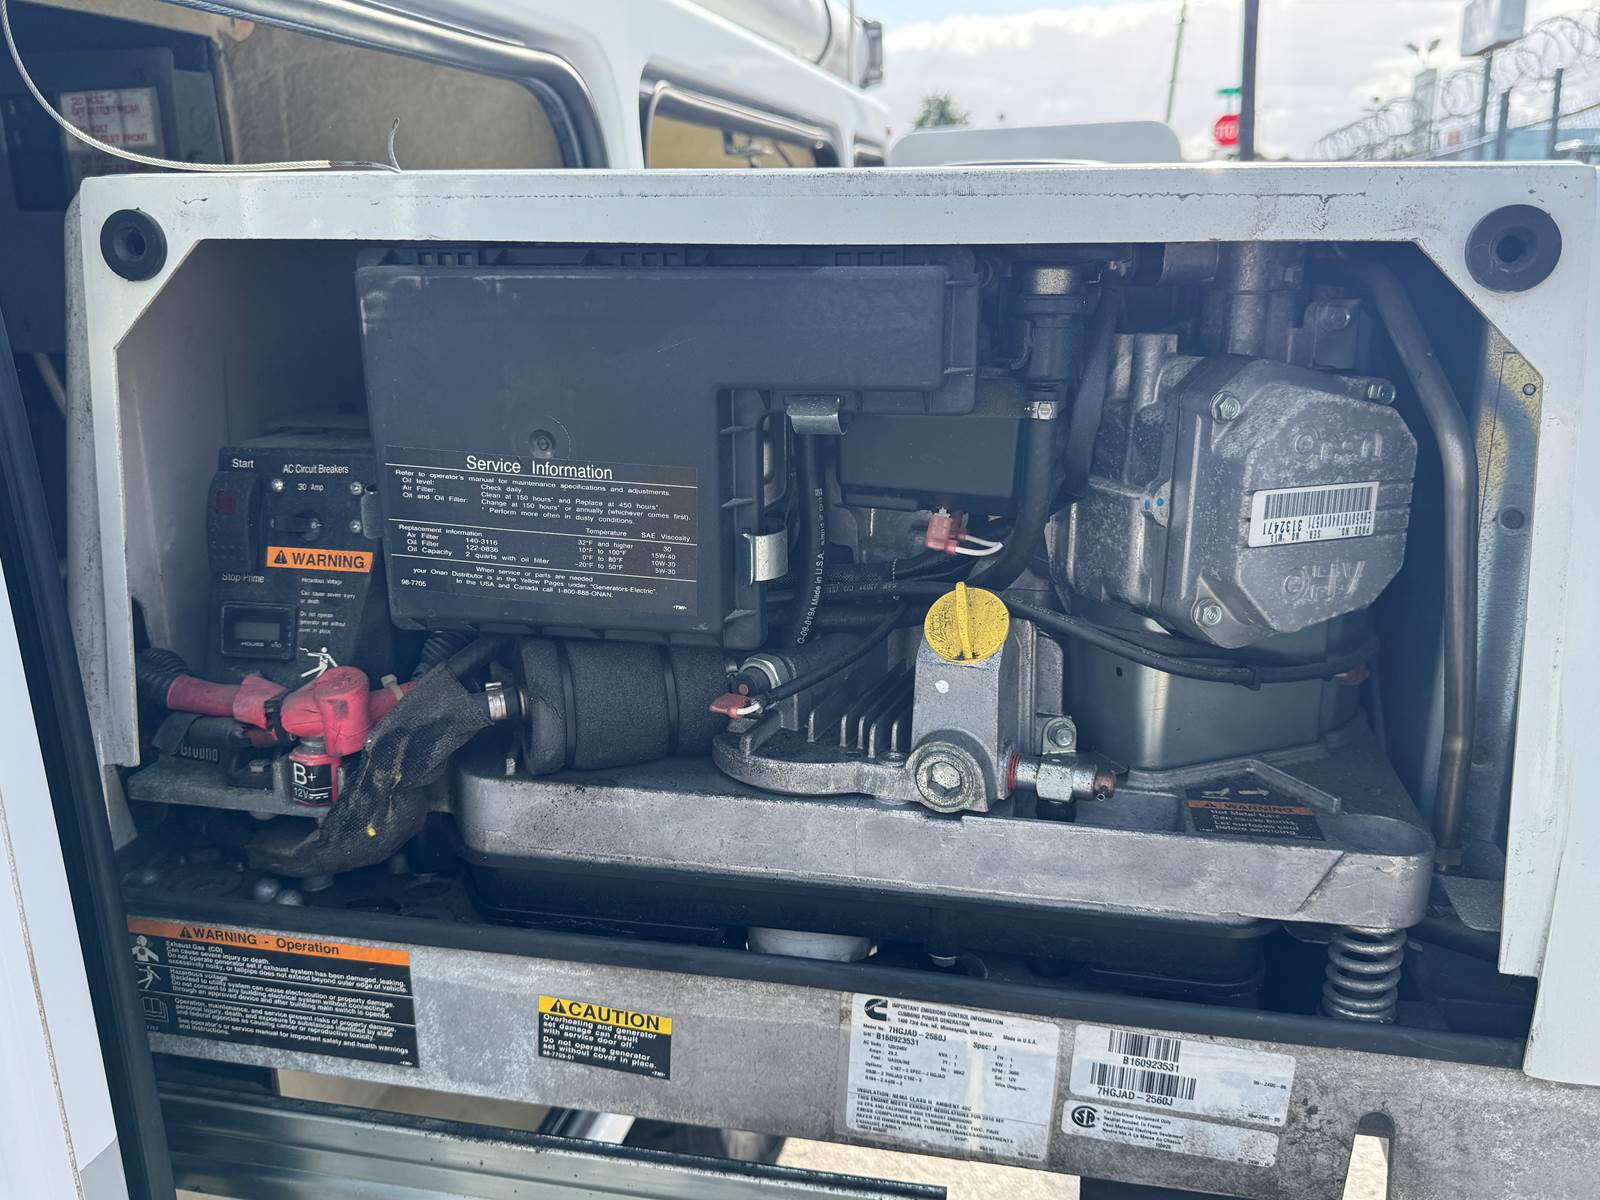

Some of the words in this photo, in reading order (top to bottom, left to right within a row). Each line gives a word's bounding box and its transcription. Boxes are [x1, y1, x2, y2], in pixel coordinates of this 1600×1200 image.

[232, 459, 254, 468] Start
[283, 464, 294, 473] AC
[295, 464, 317, 474] Circuit
[318, 465, 349, 474] Breakers
[466, 456, 521, 473] Service
[532, 461, 613, 480] Information
[310, 484, 324, 493] Amp
[395, 469, 414, 477] Refer
[512, 479, 556, 487] maintenance
[560, 483, 606, 491] specifications
[627, 487, 671, 496] adjustments.
[416, 485, 436, 493] Filter:
[506, 485, 524, 494] daily.
[398, 524, 442, 533] Replacement
[585, 528, 627, 537] Temperature
[1263, 520, 1302, 535] 3132471
[466, 538, 498, 546] 140-3116
[613, 542, 633, 550] higher
[660, 534, 691, 543] Viscosity
[421, 547, 453, 556] Capacity
[292, 552, 365, 568] WARNING
[651, 560, 676, 568] 10W-30
[816, 550, 824, 574] U.S.A.
[222, 572, 241, 584] Stop
[243, 573, 265, 583] Prime
[655, 567, 676, 575] 5W-30
[401, 579, 427, 587] 98-7705
[814, 576, 822, 584] in
[811, 586, 822, 606] Made
[293, 763, 317, 785] B+
[294, 786, 309, 799] 12V
[193, 927, 258, 945] WARNING
[276, 937, 340, 955] Operation
[568, 1002, 660, 1031] CAUTION
[892, 1002, 920, 1013] IMPORTANT
[920, 1006, 947, 1017] EMISSIONS
[947, 1010, 969, 1020] CONTROL
[970, 1013, 1004, 1025] INFORMATION
[897, 1010, 921, 1020] CUMMINS
[921, 1013, 939, 1023] POWER
[939, 1016, 970, 1027] GENERATION
[543, 1013, 594, 1030] Overheating
[597, 1024, 613, 1032] and
[616, 1027, 657, 1039] generator
[559, 1023, 592, 1035] damage
[595, 1030, 610, 1038] can
[614, 1034, 639, 1043] result
[543, 1028, 560, 1036] with
[564, 1032, 594, 1042] service
[597, 1036, 617, 1046] door
[620, 1041, 635, 1049] off.
[876, 1031, 919, 1046] B160923531
[543, 1036, 555, 1044] Do
[557, 1039, 571, 1047] not
[574, 1042, 607, 1053] operate
[609, 1048, 651, 1061] generator
[559, 1046, 590, 1057] without
[593, 1053, 616, 1062] cover
[620, 1056, 628, 1064] in
[631, 1059, 657, 1069] place.
[1123, 1056, 1179, 1073] B160923531
[1097, 1087, 1135, 1101] 7HGJAD
[1145, 1093, 1174, 1106] 2560J
